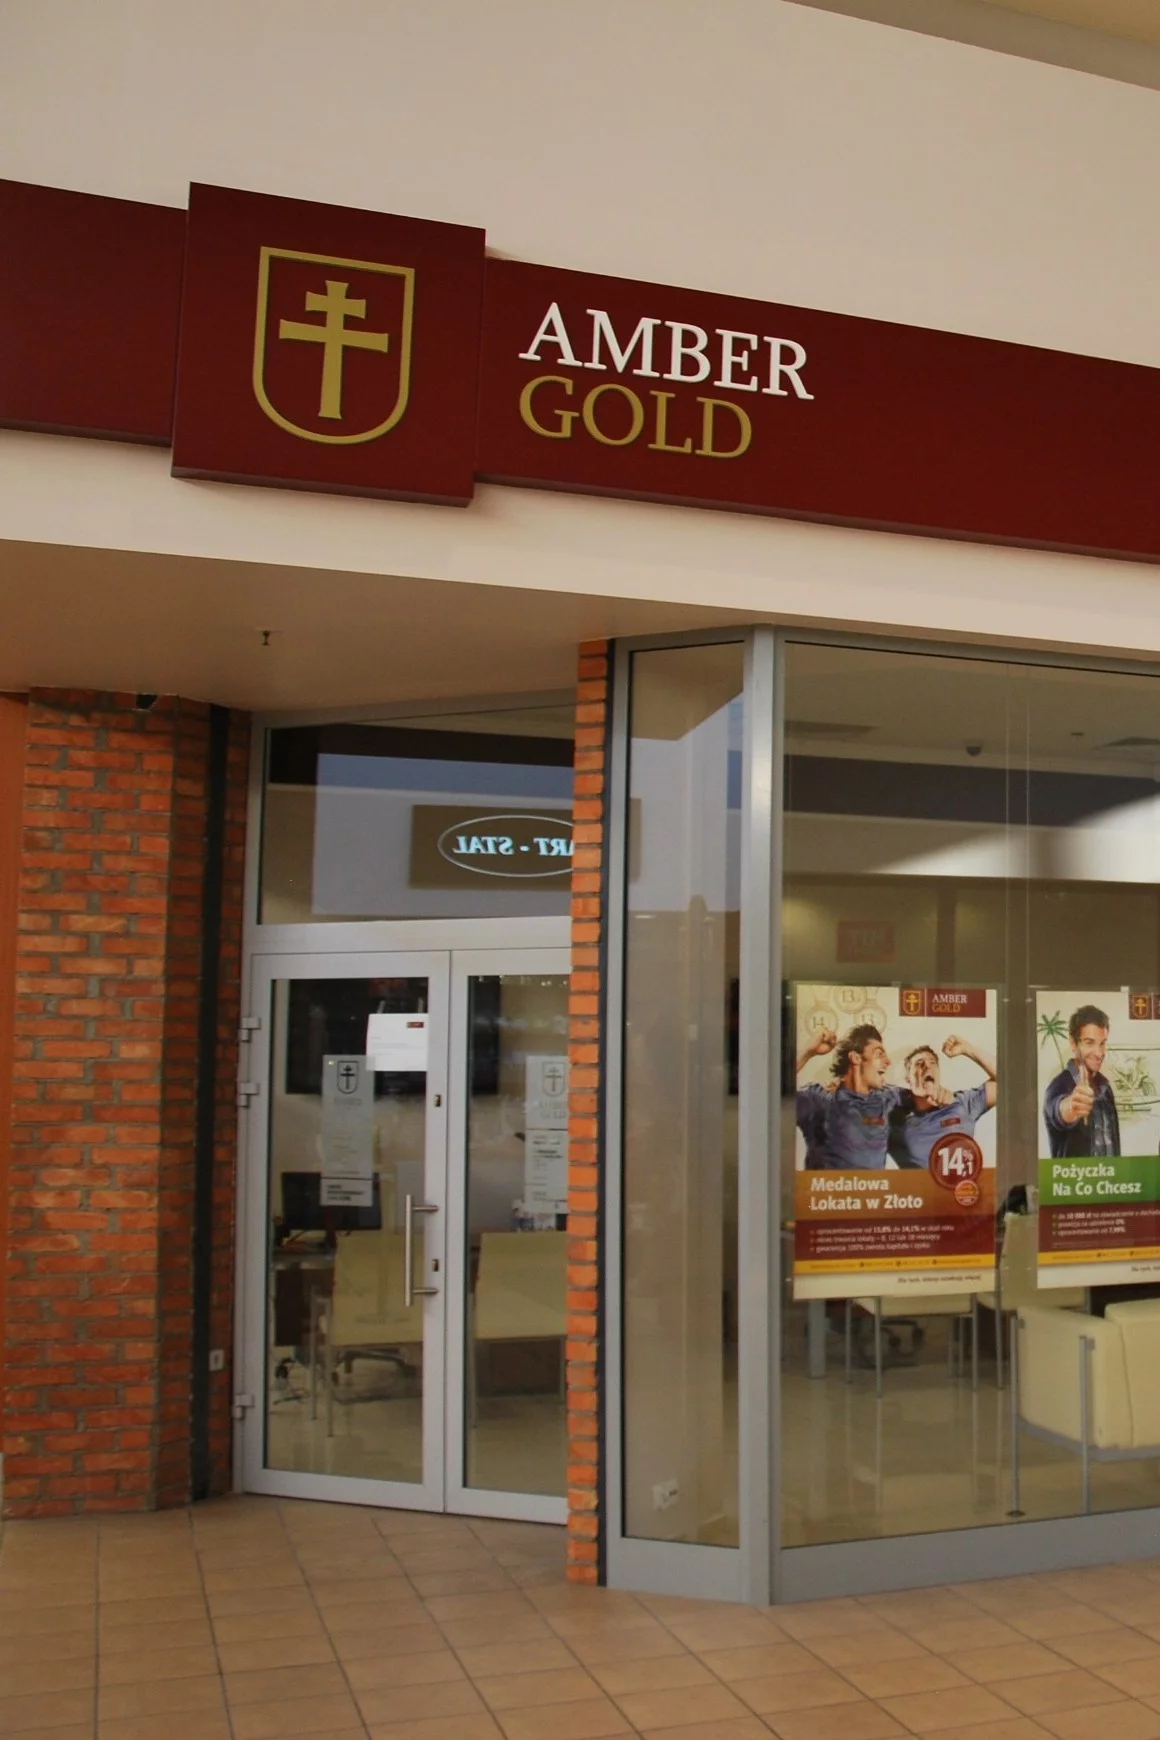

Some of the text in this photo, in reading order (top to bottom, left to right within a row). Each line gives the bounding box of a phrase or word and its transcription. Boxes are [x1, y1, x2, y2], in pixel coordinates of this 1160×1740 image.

[518, 302, 815, 400] AMBER
[519, 375, 752, 458] GOLD
[931, 994, 968, 1004] AMBER
[931, 1003, 961, 1013] GOLD
[1052, 1163, 1115, 1181] Pożyczka
[810, 1177, 889, 1192] Medalowa
[1053, 1180, 1142, 1196] Na Co Chcesz
[810, 1194, 923, 1211] Lokata w Złoto
